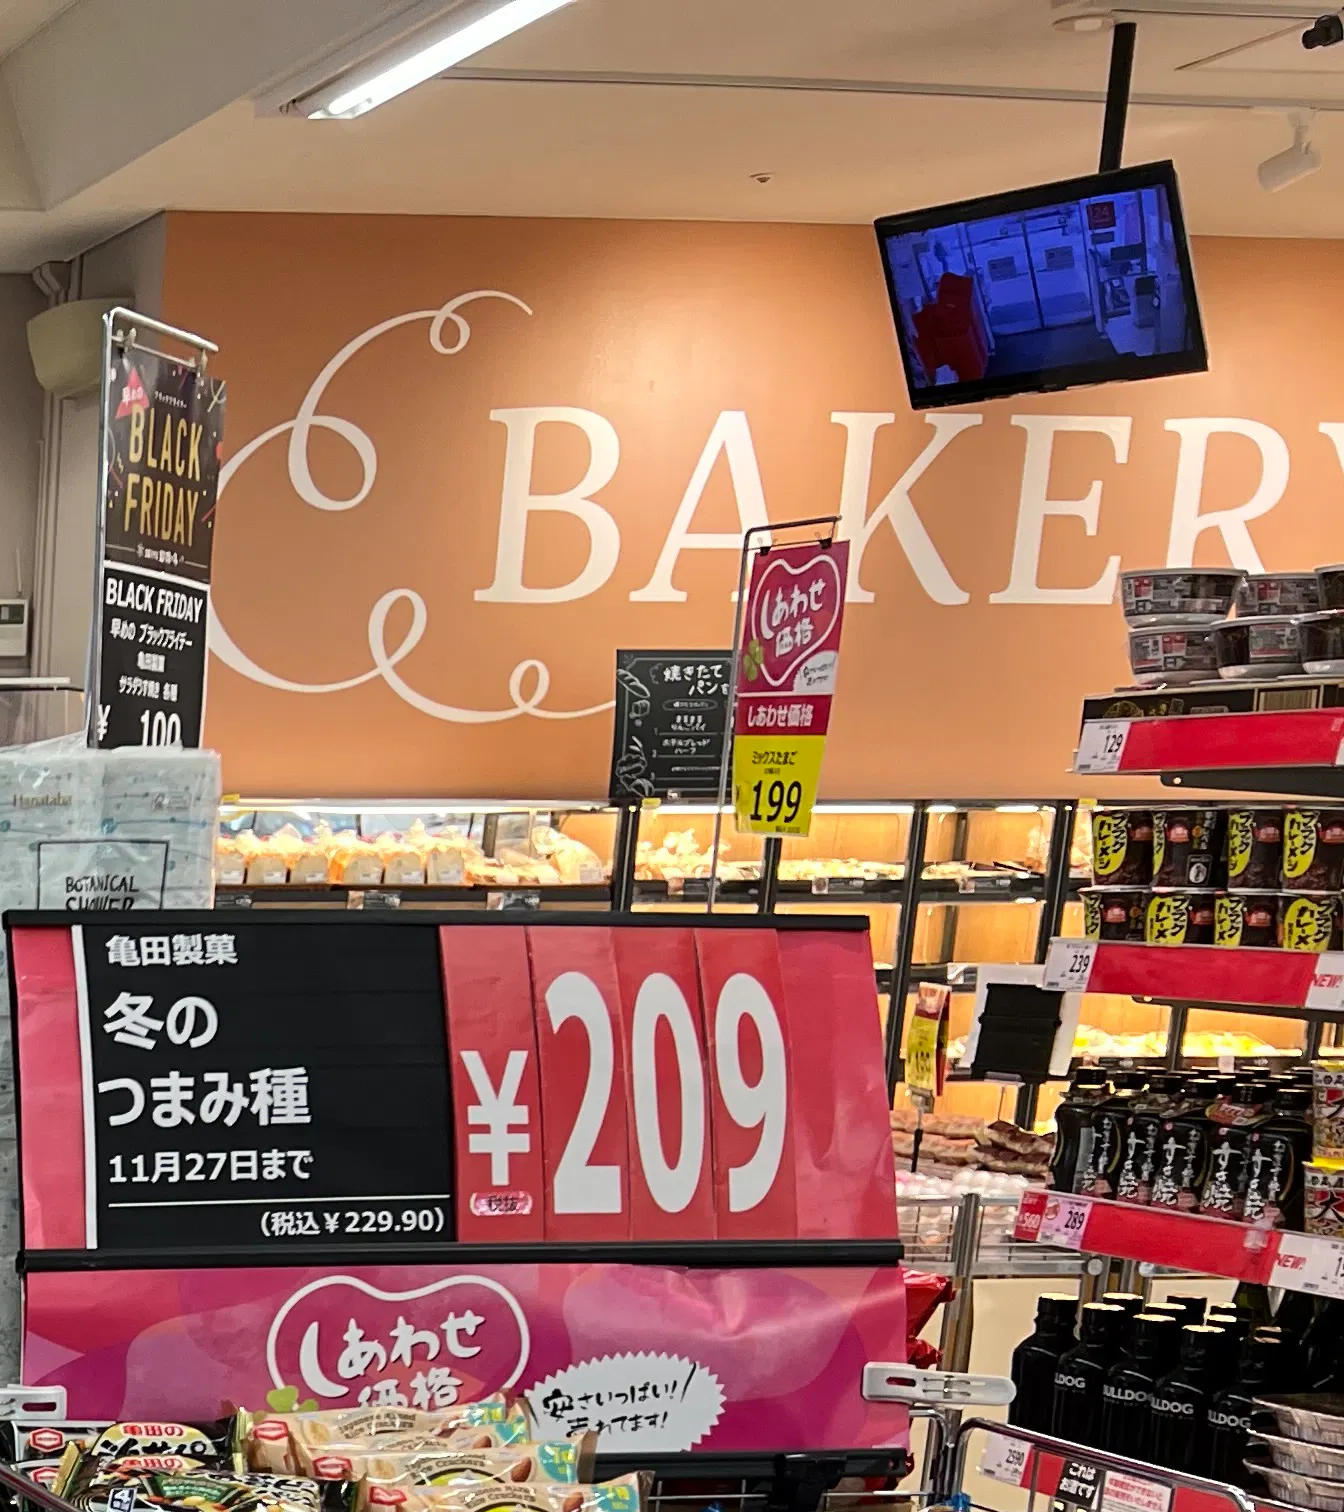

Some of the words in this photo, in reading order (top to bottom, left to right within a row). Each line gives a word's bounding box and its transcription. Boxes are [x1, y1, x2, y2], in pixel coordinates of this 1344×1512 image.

[129, 403, 203, 482] BLACK
[124, 473, 199, 547] FRIDAY
[473, 406, 1344, 606] BAKER
[105, 578, 155, 613] BLACK
[156, 588, 203, 623] FRIDAY
[761, 578, 827, 640] しあわせ
[776, 617, 814, 657] 価格
[747, 704, 813, 728] しあわせ価格
[1103, 734, 1123, 753] 129
[750, 779, 802, 823] 199
[65, 875, 140, 894] BOTANICAL
[105, 934, 238, 966] 亀田製菓
[1069, 954, 1091, 975] 239
[103, 992, 219, 1049] 冬の
[97, 1066, 312, 1128] つまみ種
[108, 1151, 313, 1184] 11月27日まで
[1064, 1211, 1085, 1230] 289
[299, 1309, 486, 1396] しあわせ
